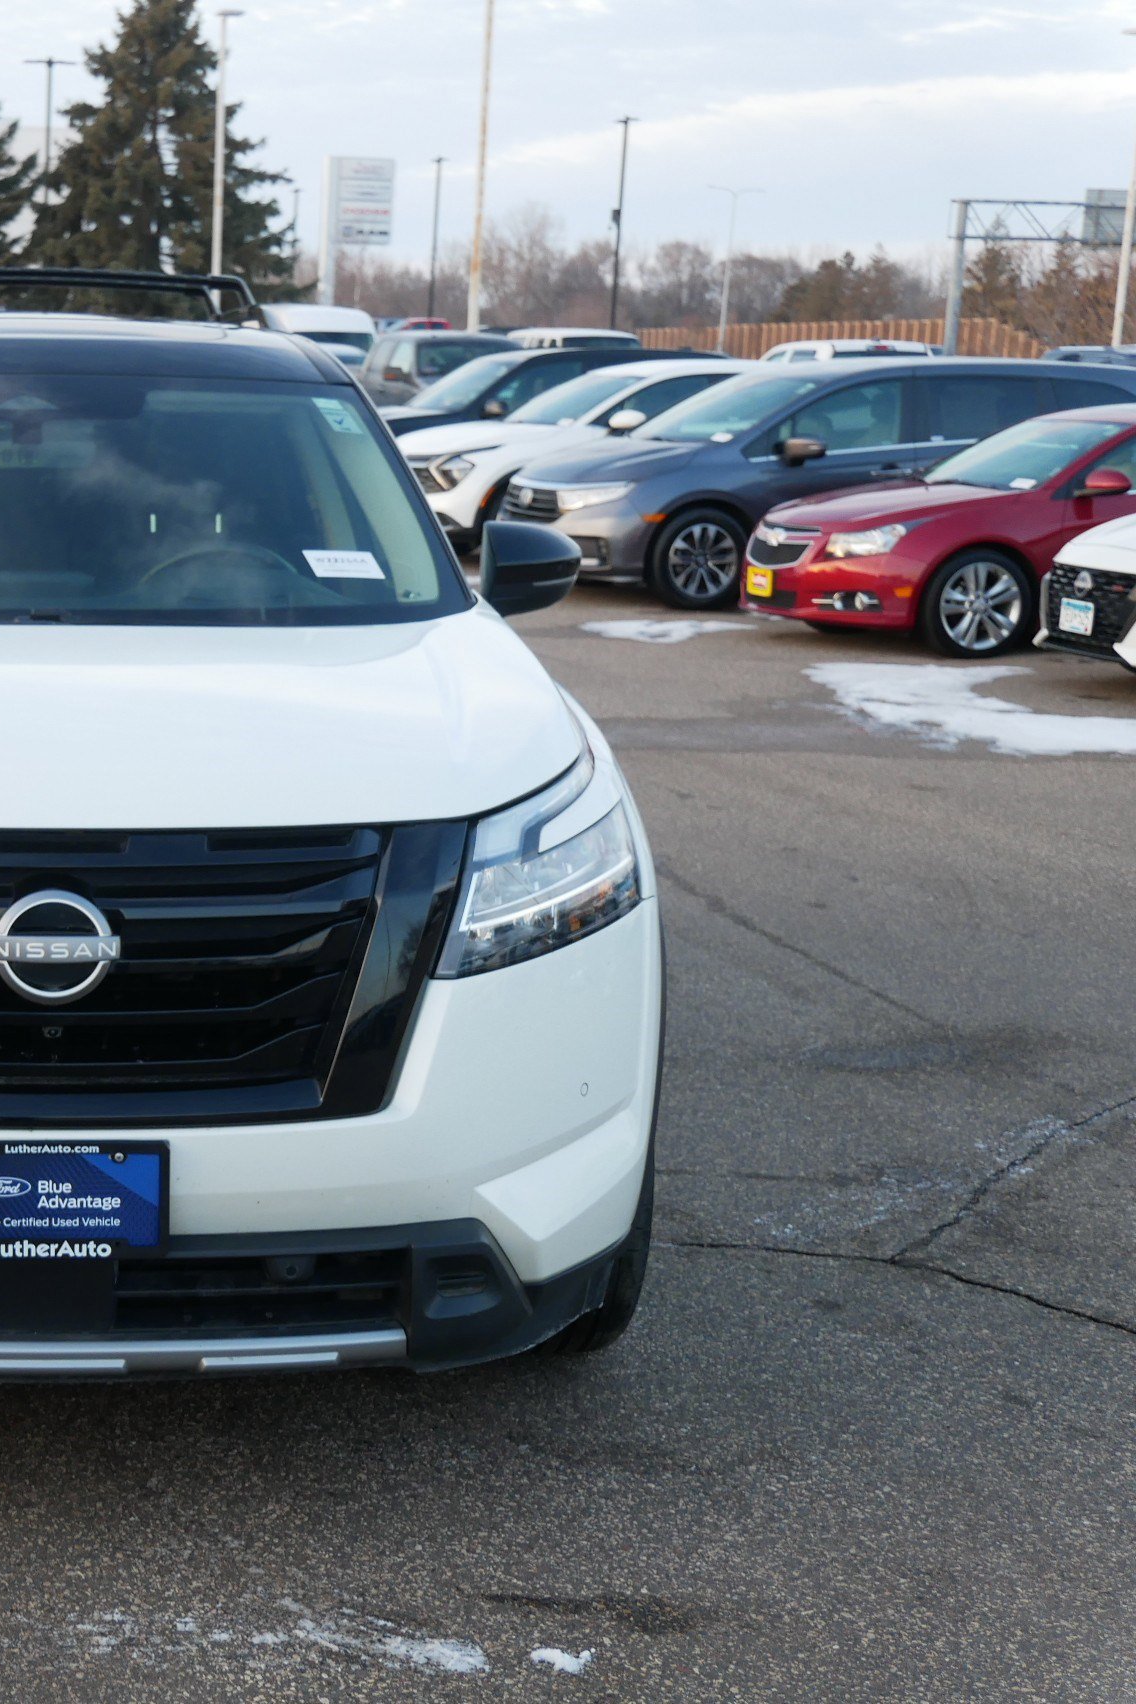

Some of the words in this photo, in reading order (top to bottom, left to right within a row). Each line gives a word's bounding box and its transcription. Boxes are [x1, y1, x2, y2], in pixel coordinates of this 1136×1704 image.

[4, 1144, 100, 1154] LutherAuto.com
[37, 1180, 72, 1193] Blue
[37, 1195, 121, 1210] Advantage
[3, 1217, 49, 1227] Certified
[52, 1217, 79, 1227] Used
[82, 1217, 121, 1227] Vehicle
